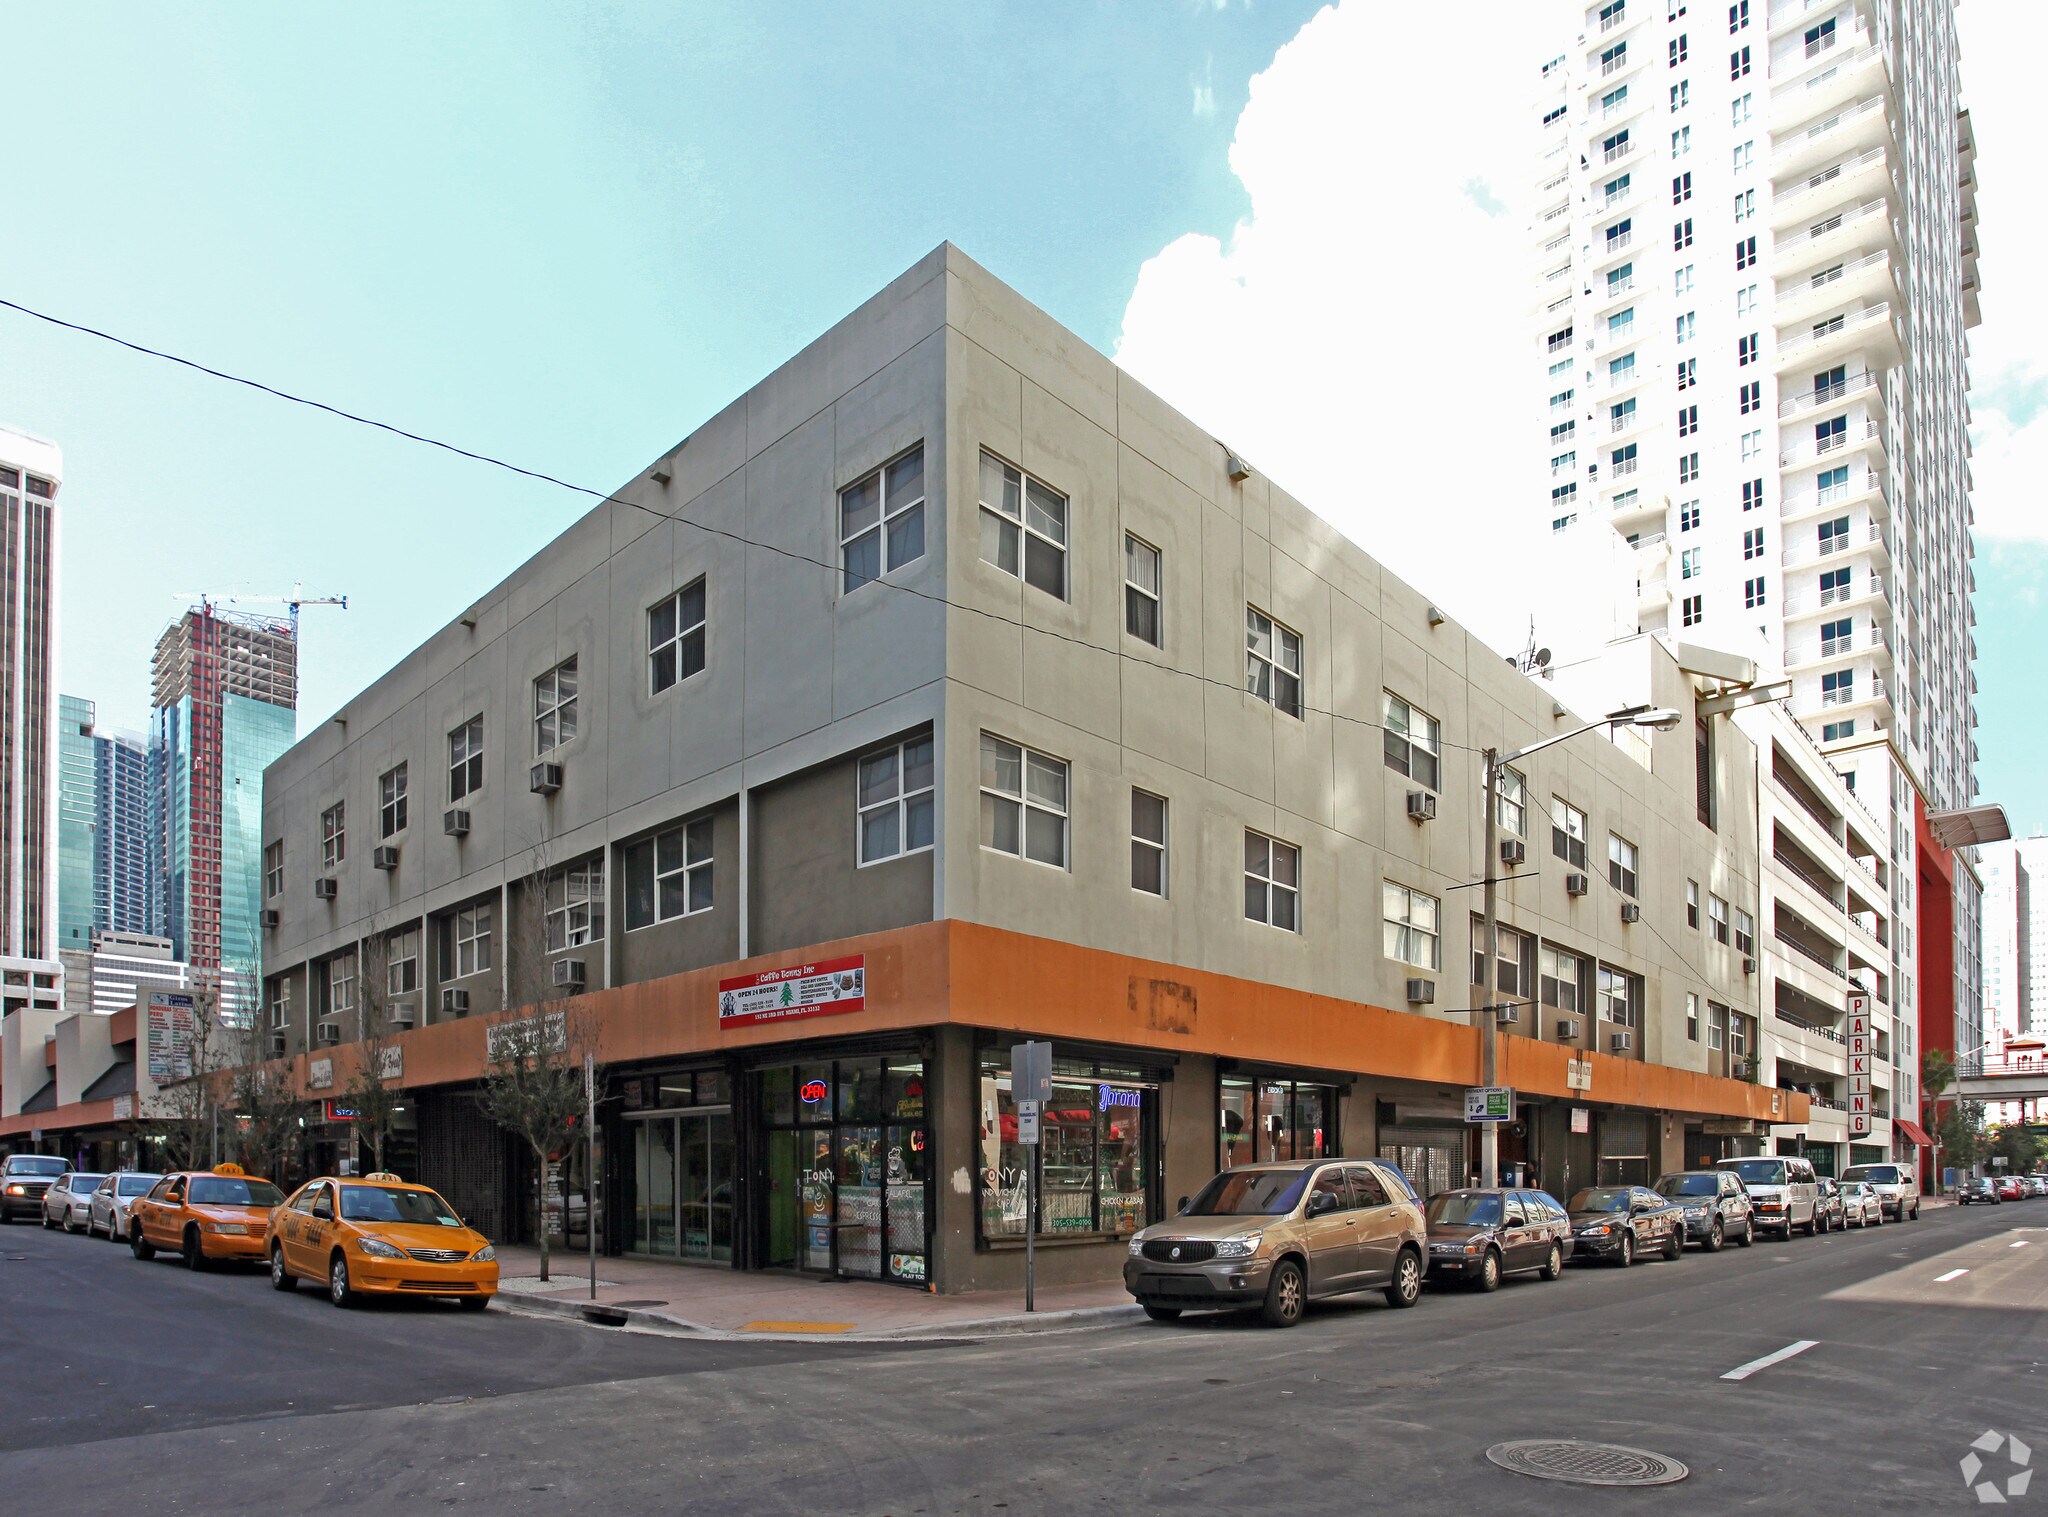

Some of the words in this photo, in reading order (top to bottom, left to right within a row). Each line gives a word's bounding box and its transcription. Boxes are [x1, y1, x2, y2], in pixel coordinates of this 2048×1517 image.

[803, 965, 815, 974] Inc
[737, 990, 752, 998] OPEN
[758, 986, 779, 995] HOURS!
[1853, 999, 1863, 1131] PARKING
[800, 1084, 826, 1099] OPEN
[1099, 1084, 1141, 1112] Corona
[221, 1166, 240, 1174] TAXI
[374, 1174, 397, 1182] TAXI
[1506, 1172, 1512, 1182] P
[885, 1188, 912, 1199] FALAFEL
[1100, 1197, 1124, 1205] CHICKEN
[1124, 1196, 1144, 1205] KABAB
